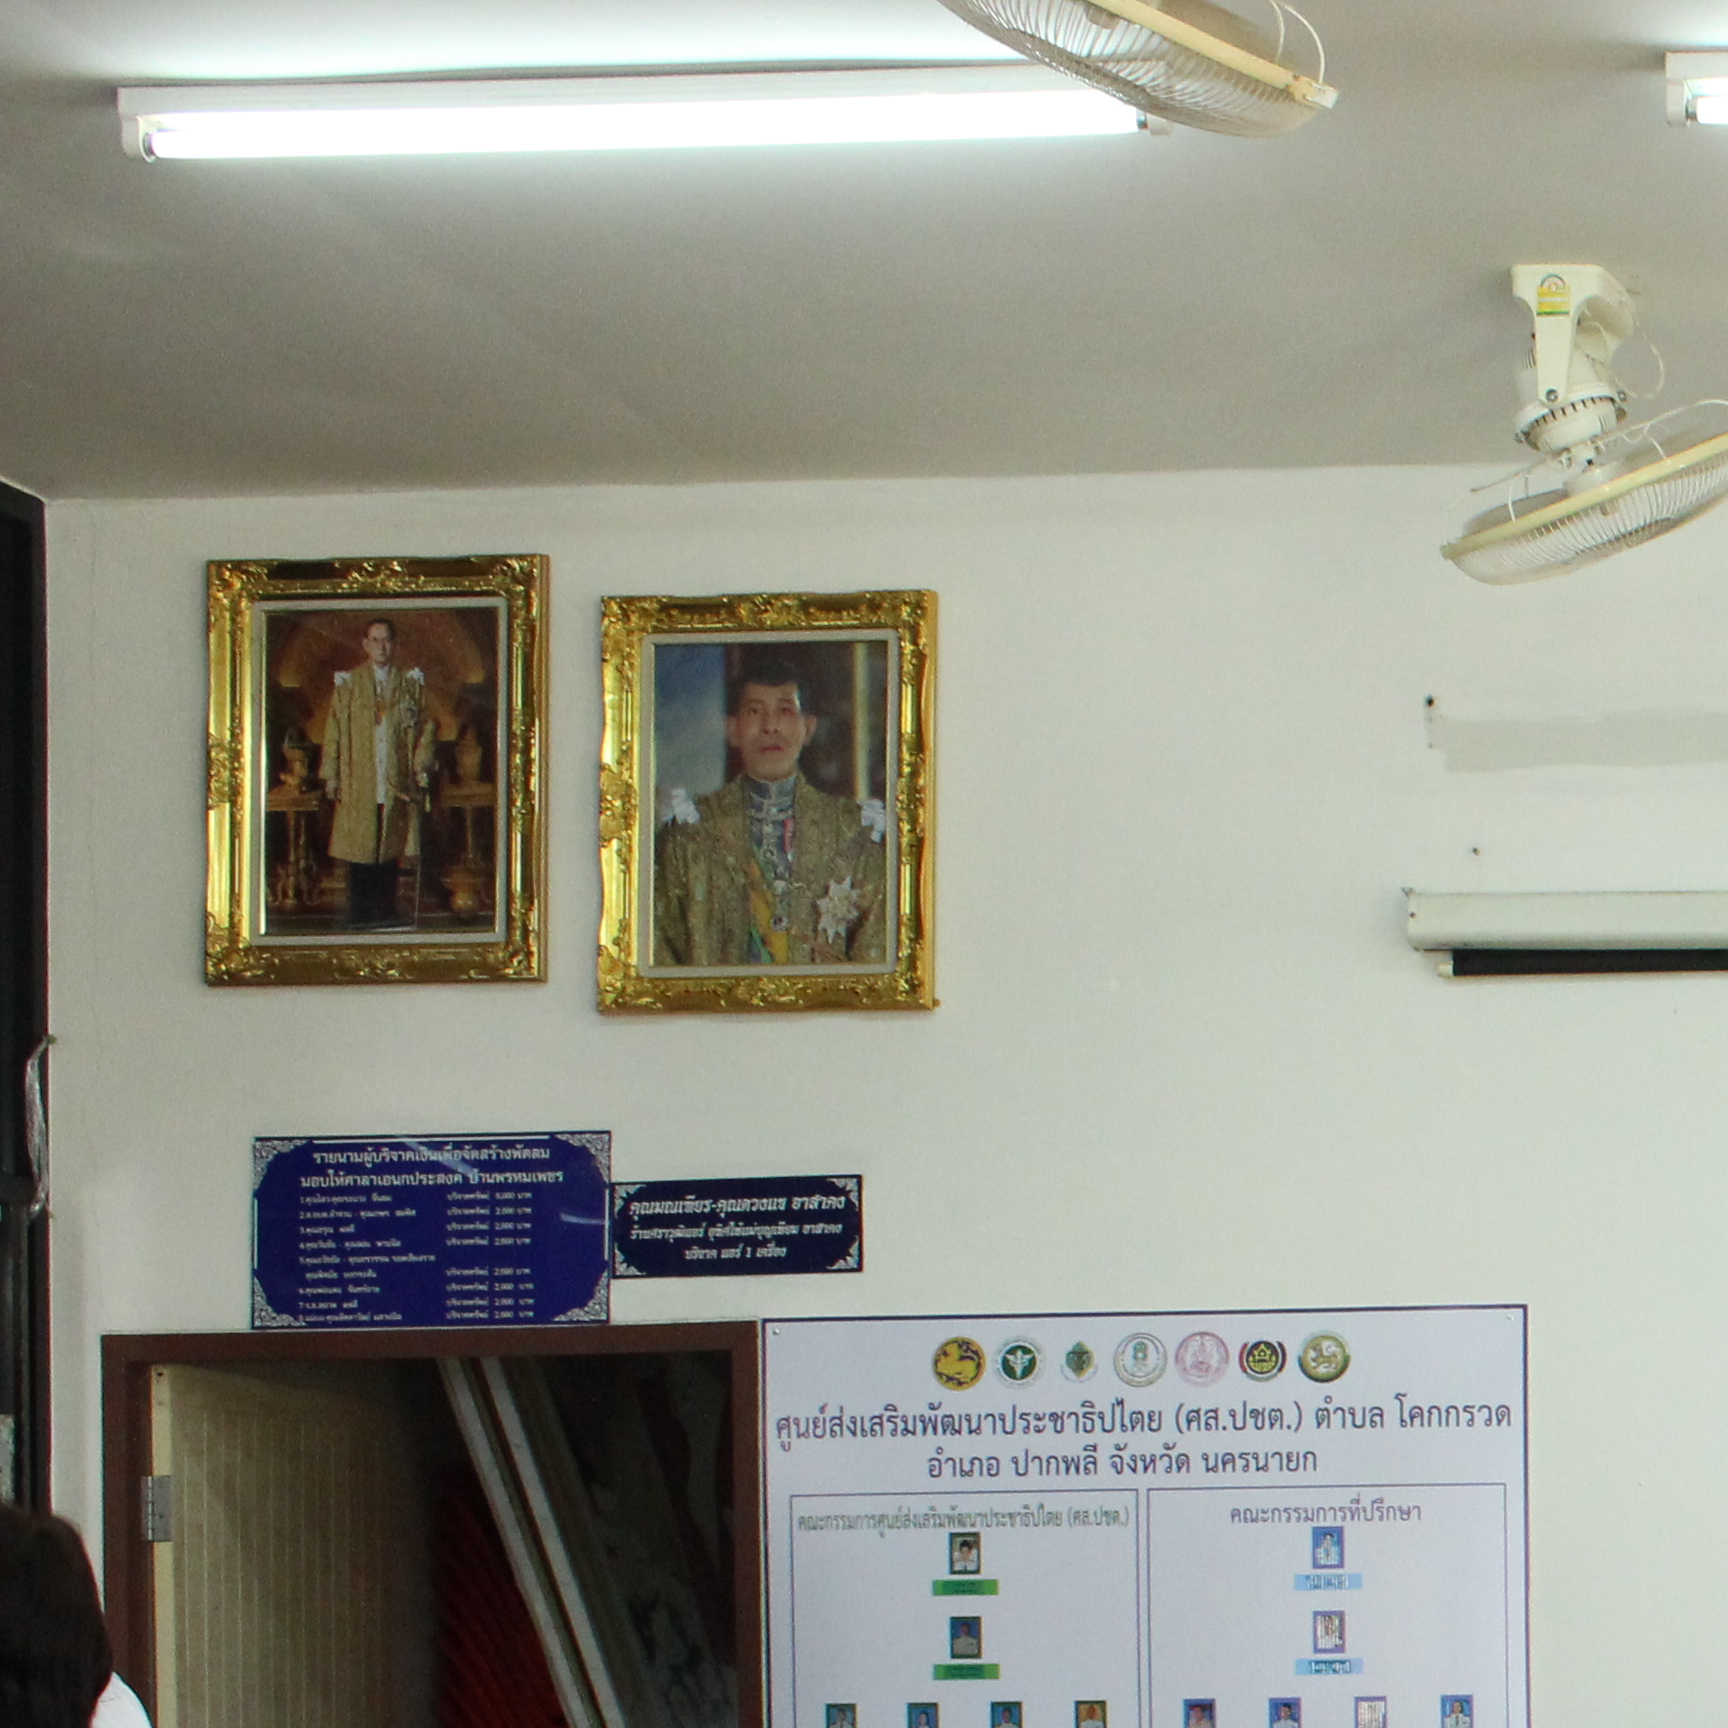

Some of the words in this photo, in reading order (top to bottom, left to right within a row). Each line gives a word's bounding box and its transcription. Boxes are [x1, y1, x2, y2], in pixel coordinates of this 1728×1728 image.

[775, 1396, 1163, 1453] ศูนย์ส่งเสริมพัฒนาประชาธิปไตย
[1174, 1400, 1303, 1436] (ศส.ปชต.)
[1313, 1395, 1385, 1430] ตำบล
[1394, 1392, 1512, 1430] โคกกรวด
[927, 1446, 1001, 1479] อำเภอ
[1010, 1443, 1099, 1477] ปากพลี
[1108, 1441, 1191, 1476] จังหวัด
[1201, 1449, 1318, 1474] นครนายก
[1229, 1492, 1422, 1525] คณะกรรมการที่ปรึกษา
